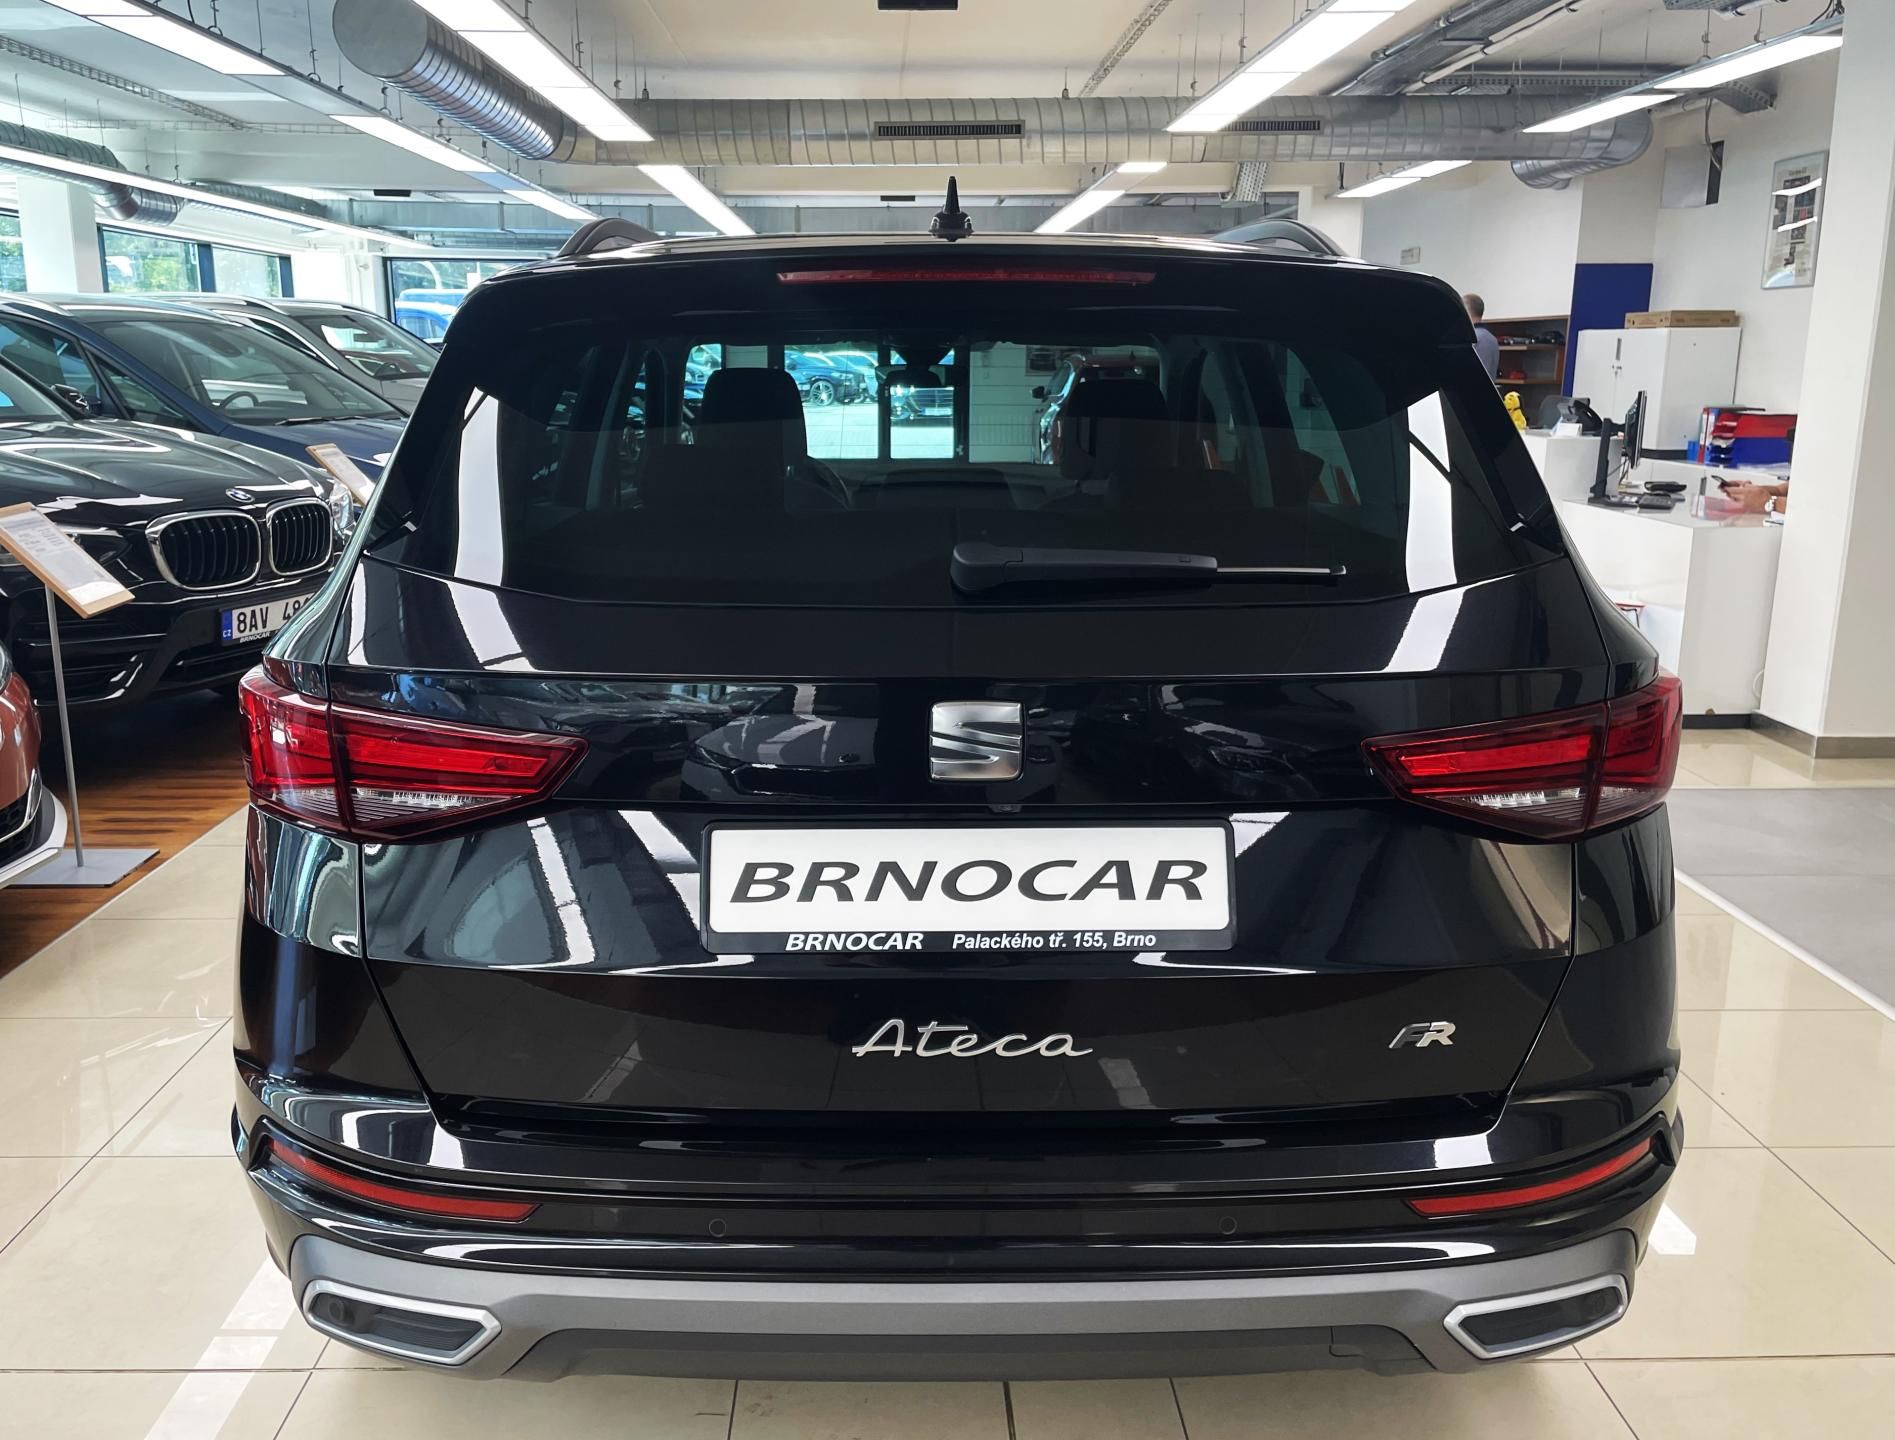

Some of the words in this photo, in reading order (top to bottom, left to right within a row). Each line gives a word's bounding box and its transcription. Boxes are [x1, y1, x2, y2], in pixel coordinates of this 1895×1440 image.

[237, 606, 269, 634] 8AV
[282, 597, 310, 621] 48
[222, 629, 231, 637] CZ
[730, 860, 1208, 903] BRNOCAR
[785, 932, 924, 951] BRNOCAR
[952, 932, 1044, 950] Palackého
[1048, 932, 1067, 949] tř.
[1072, 931, 1108, 950] 155,
[1112, 931, 1157, 948] Brno
[851, 1018, 1093, 1058] Ateca
[1388, 1021, 1456, 1049] FR
